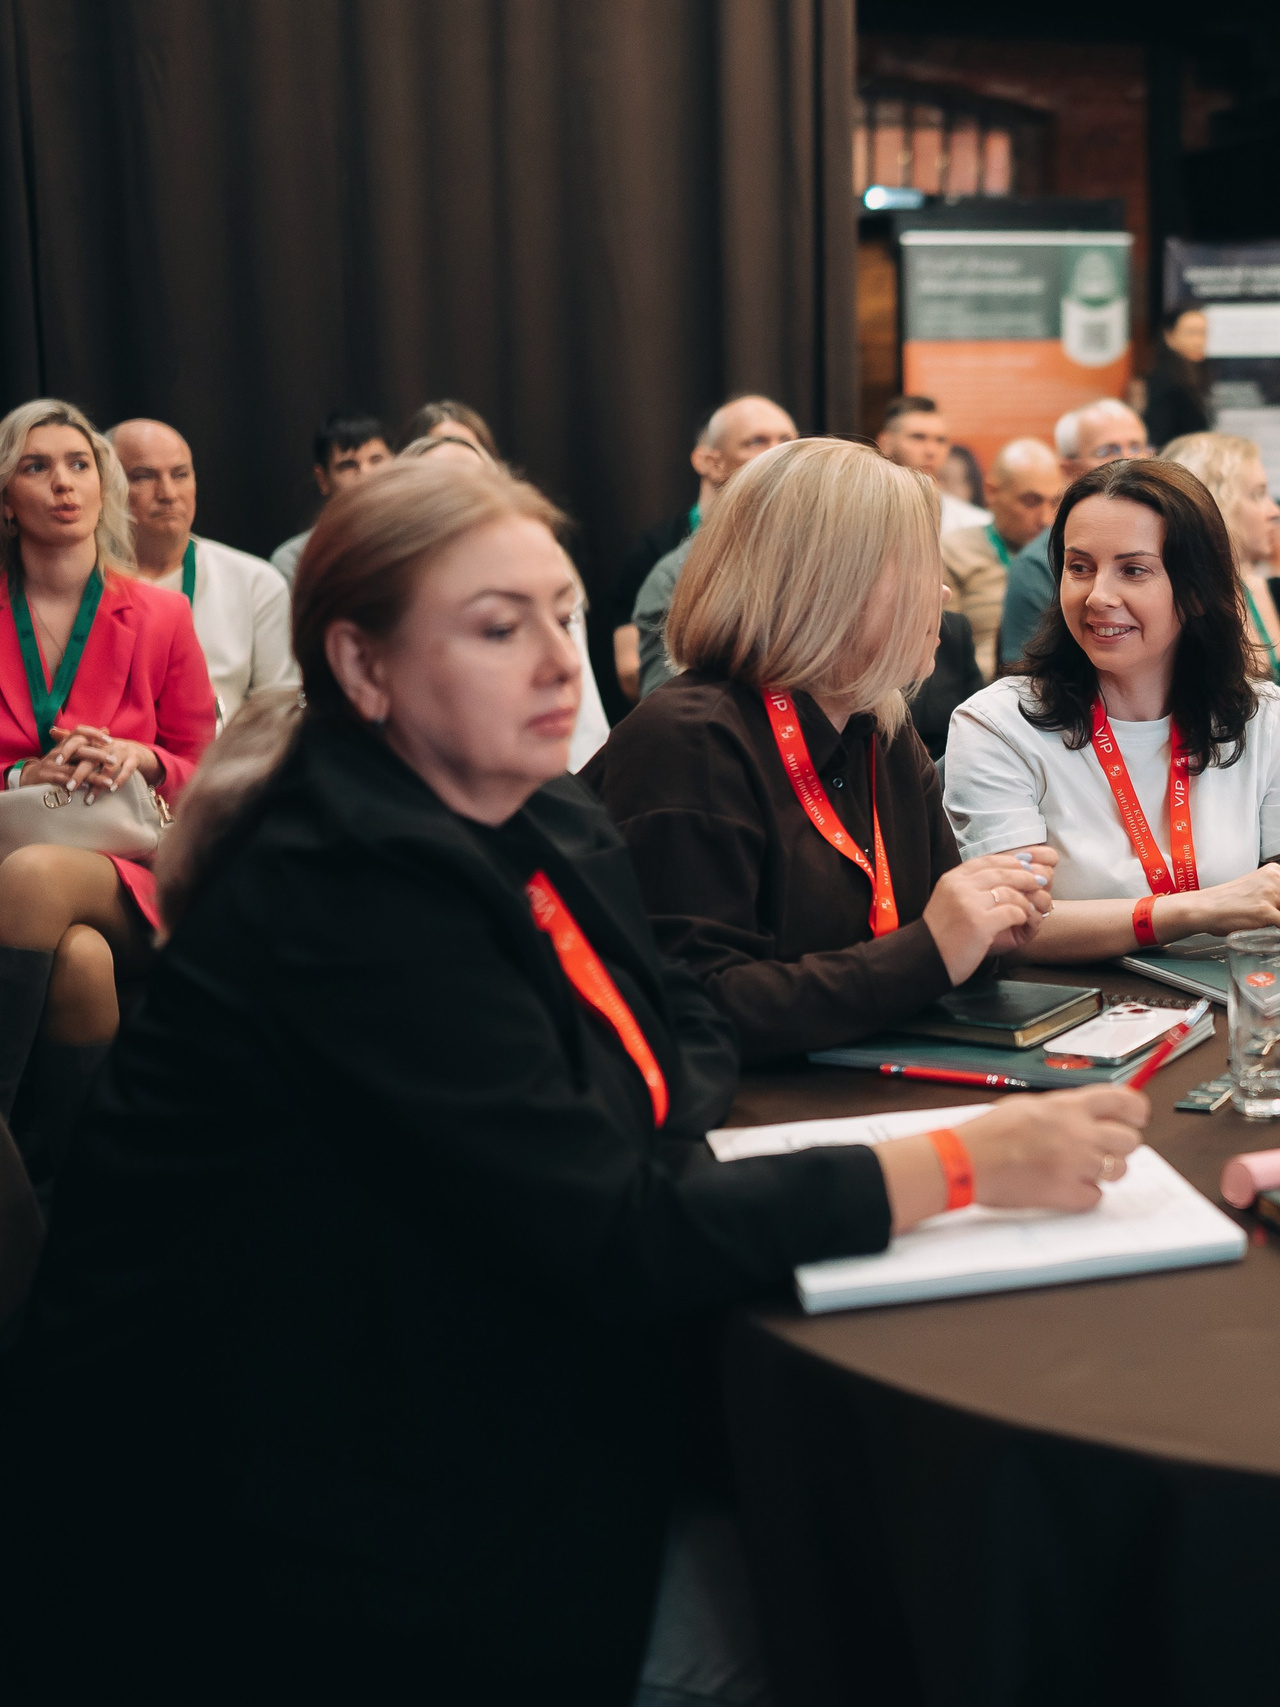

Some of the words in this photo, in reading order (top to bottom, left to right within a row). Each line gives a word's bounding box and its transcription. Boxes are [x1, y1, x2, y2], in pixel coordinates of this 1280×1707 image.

[769, 687, 788, 711] IP
[1095, 725, 1113, 753] VIP
[1175, 780, 1185, 807] VIP
[1116, 788, 1149, 860] МИЛЛИОНЕРОВ
[1133, 809, 1147, 833] КЛУБ
